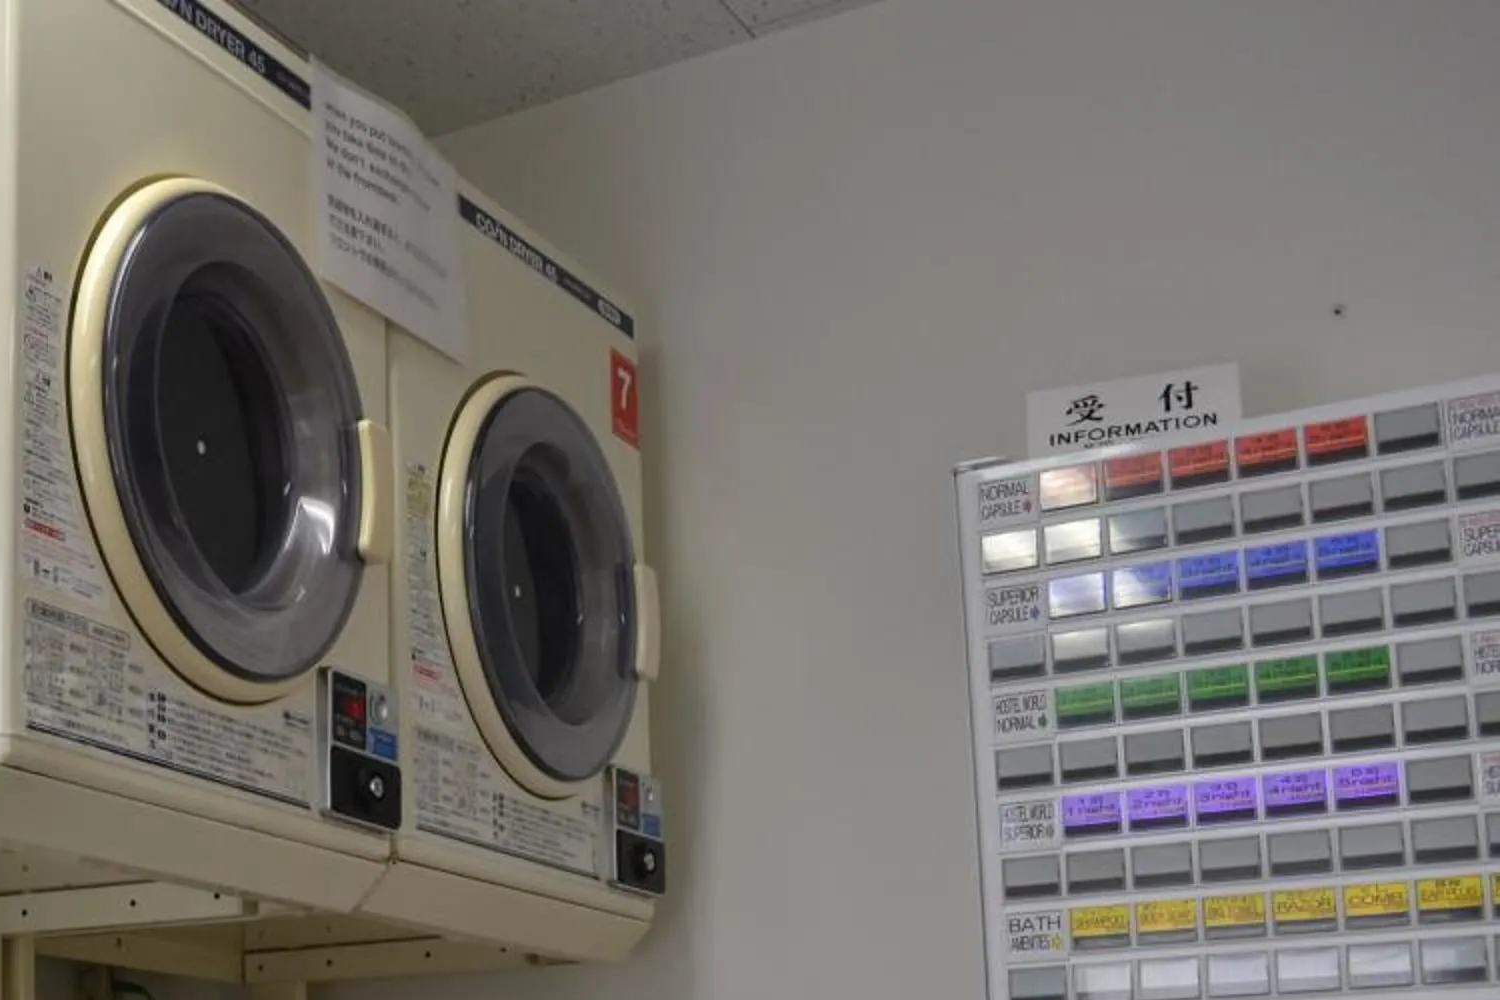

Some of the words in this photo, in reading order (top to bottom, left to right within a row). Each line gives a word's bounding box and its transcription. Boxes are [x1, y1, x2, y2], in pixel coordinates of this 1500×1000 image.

[195, 8, 246, 60] DRYER
[617, 367, 633, 410] 7
[1049, 413, 1218, 447] INFORMATION
[981, 480, 1029, 500] NORMAL
[981, 500, 1021, 520] CAPSULE
[987, 587, 1039, 607] SUPERIOR
[989, 606, 1029, 625] CAPSULE
[997, 714, 1036, 733] NORMAL
[1009, 915, 1061, 934] BATH
